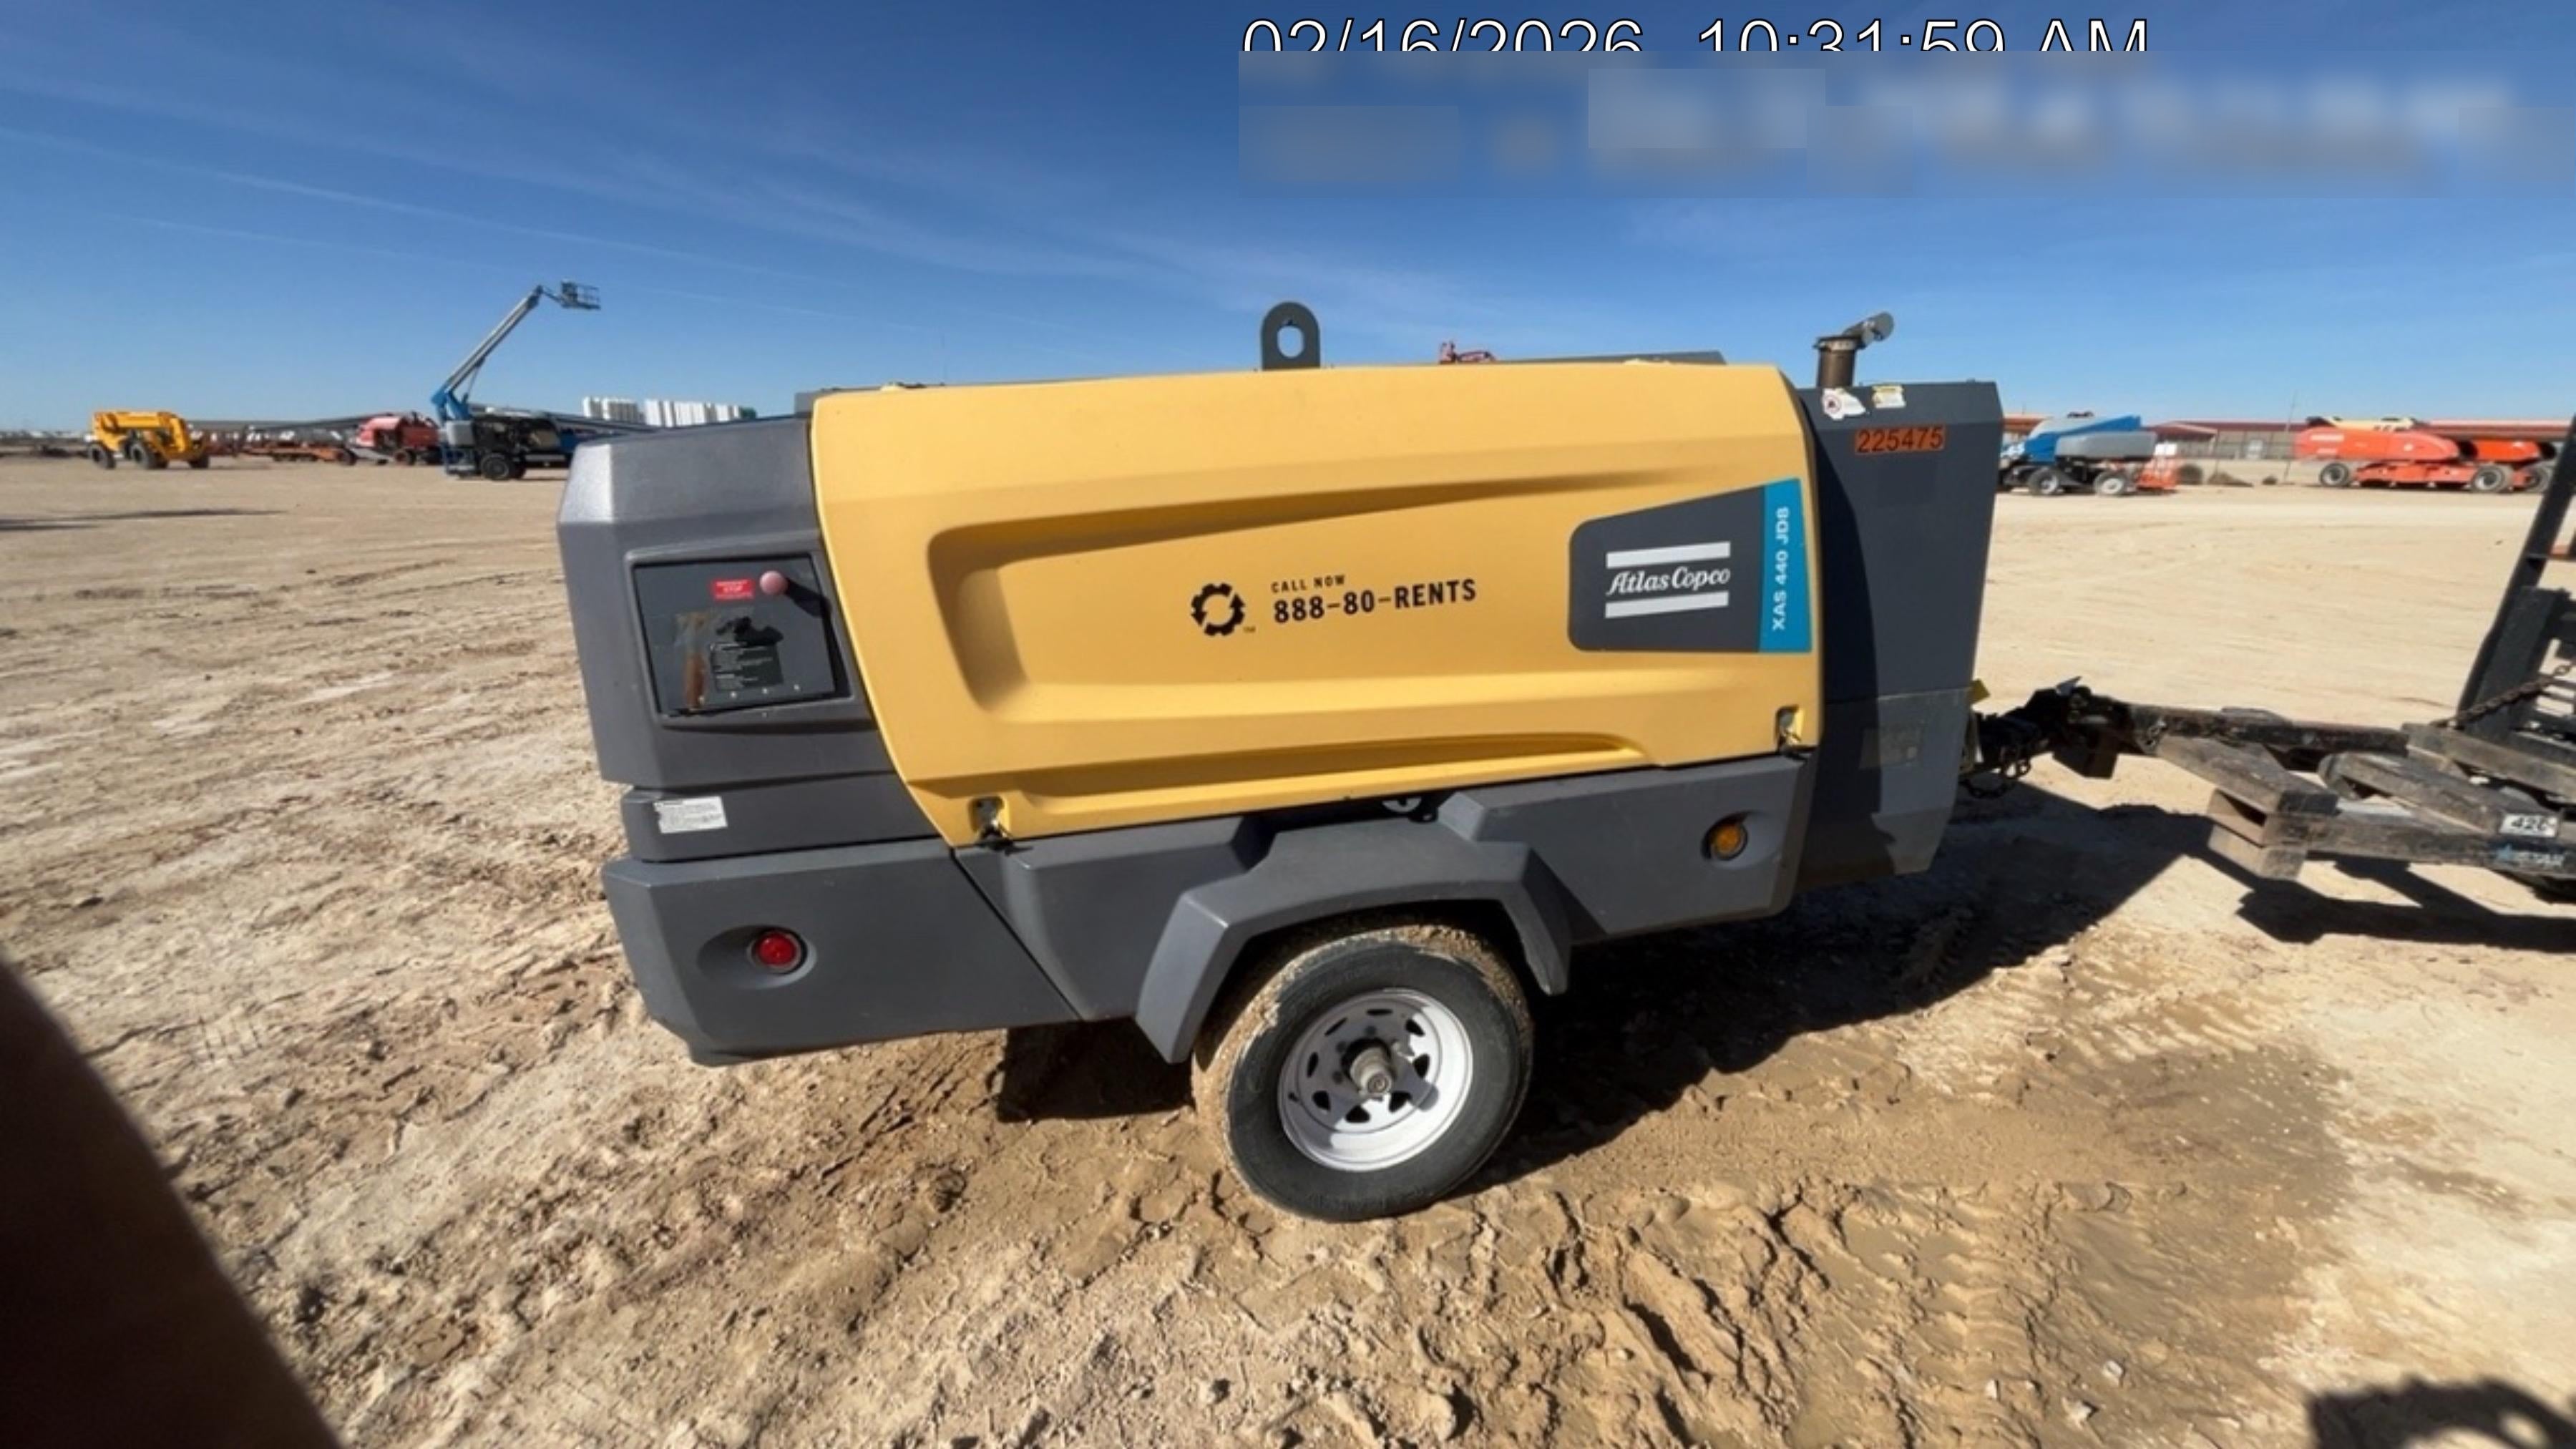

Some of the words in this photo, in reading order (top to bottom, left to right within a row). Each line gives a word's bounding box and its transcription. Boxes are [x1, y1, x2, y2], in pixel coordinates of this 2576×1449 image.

[1857, 426, 1944, 452] 225475
[1606, 570, 1669, 595] Atlas
[1672, 566, 1731, 590] Copco
[1774, 550, 1789, 585] 440
[1271, 582, 1307, 594] CALL
[1314, 575, 1345, 589] NOW
[1274, 578, 1477, 624] 888-80-RENTS
[1772, 590, 1787, 631] XAS
